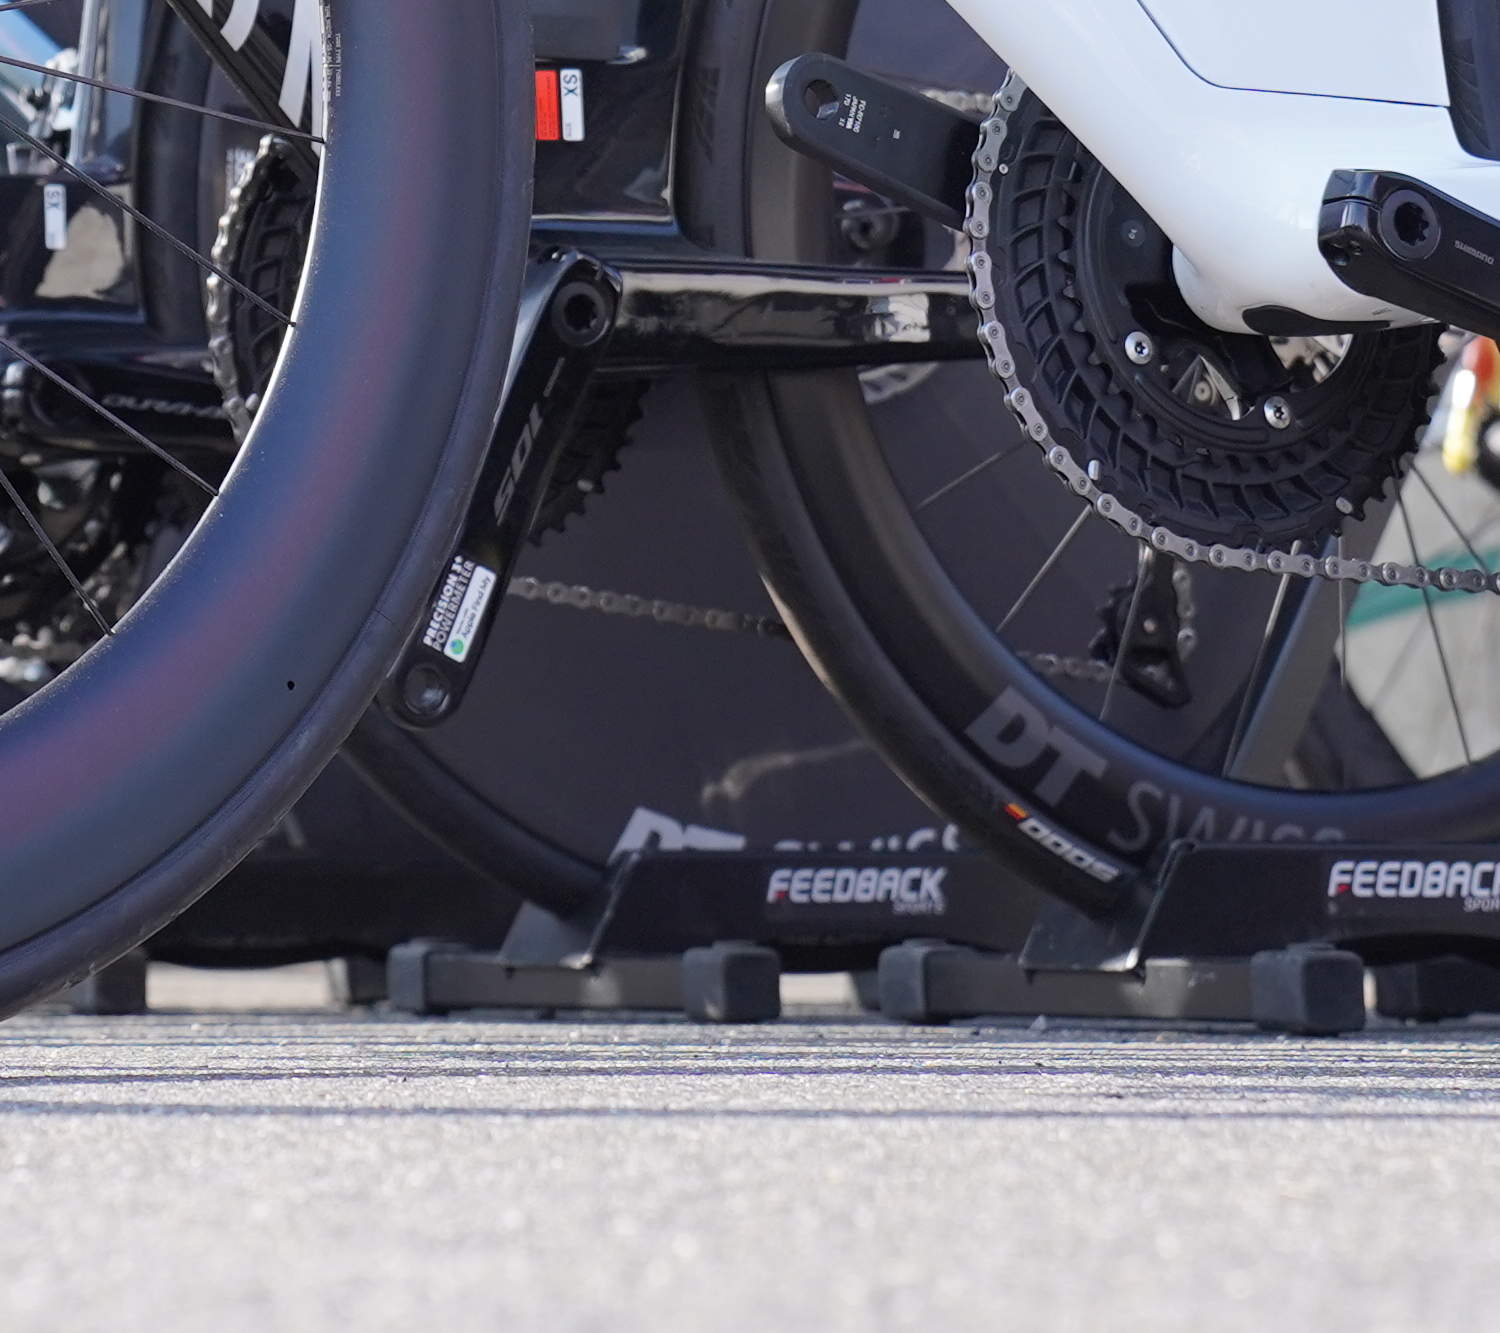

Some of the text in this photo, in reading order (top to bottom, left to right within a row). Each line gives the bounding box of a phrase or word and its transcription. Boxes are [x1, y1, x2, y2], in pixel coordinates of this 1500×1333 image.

[563, 74, 579, 97] SX
[493, 402, 543, 525] 105
[423, 573, 459, 647] PRECISION
[431, 560, 476, 652] POWERMETER
[966, 686, 1108, 809] DT
[765, 866, 948, 905] FEEDBACK
